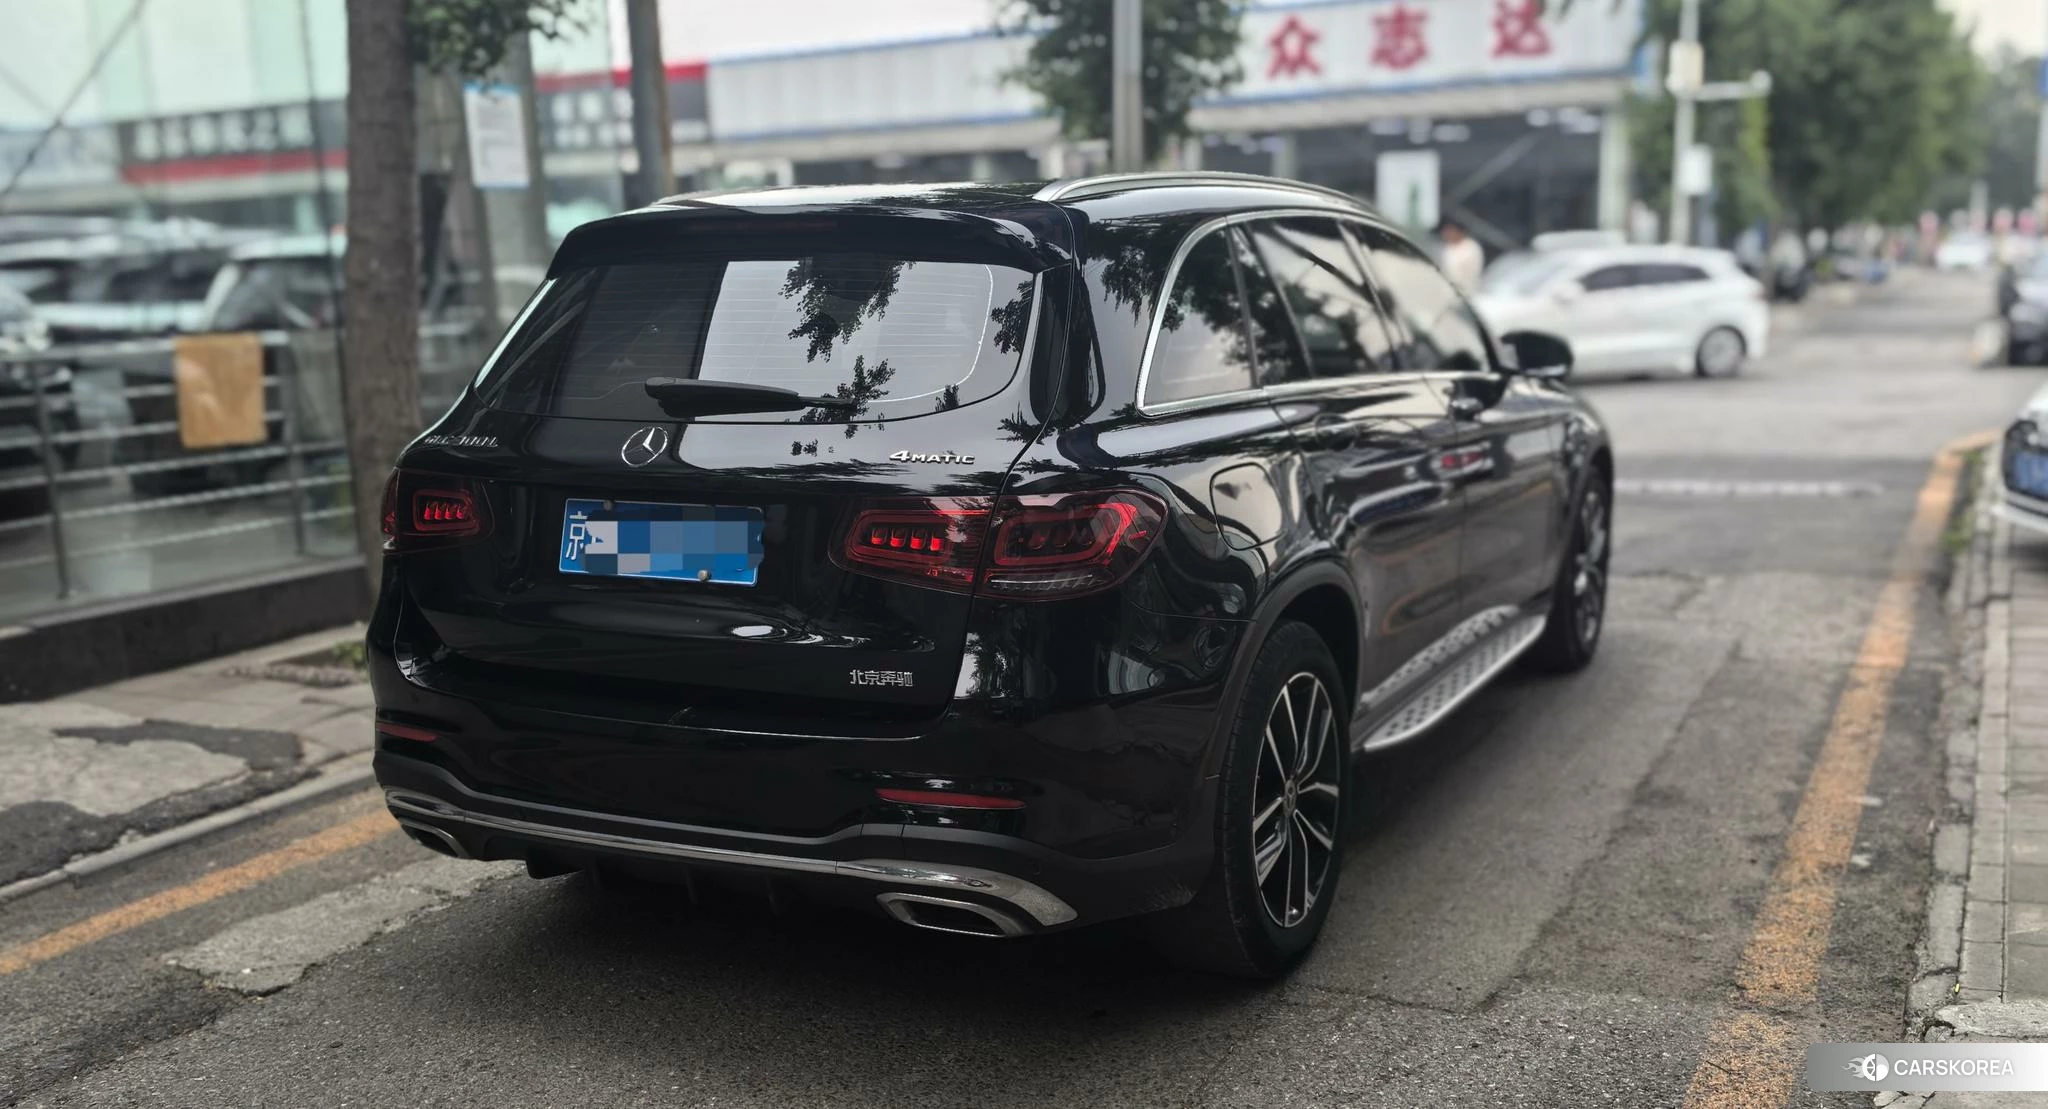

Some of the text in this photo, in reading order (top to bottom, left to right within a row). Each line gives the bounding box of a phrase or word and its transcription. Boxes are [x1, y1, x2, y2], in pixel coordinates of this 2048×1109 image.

[889, 450, 975, 464] 4MATIC
[849, 669, 913, 687] 北京奔驰
